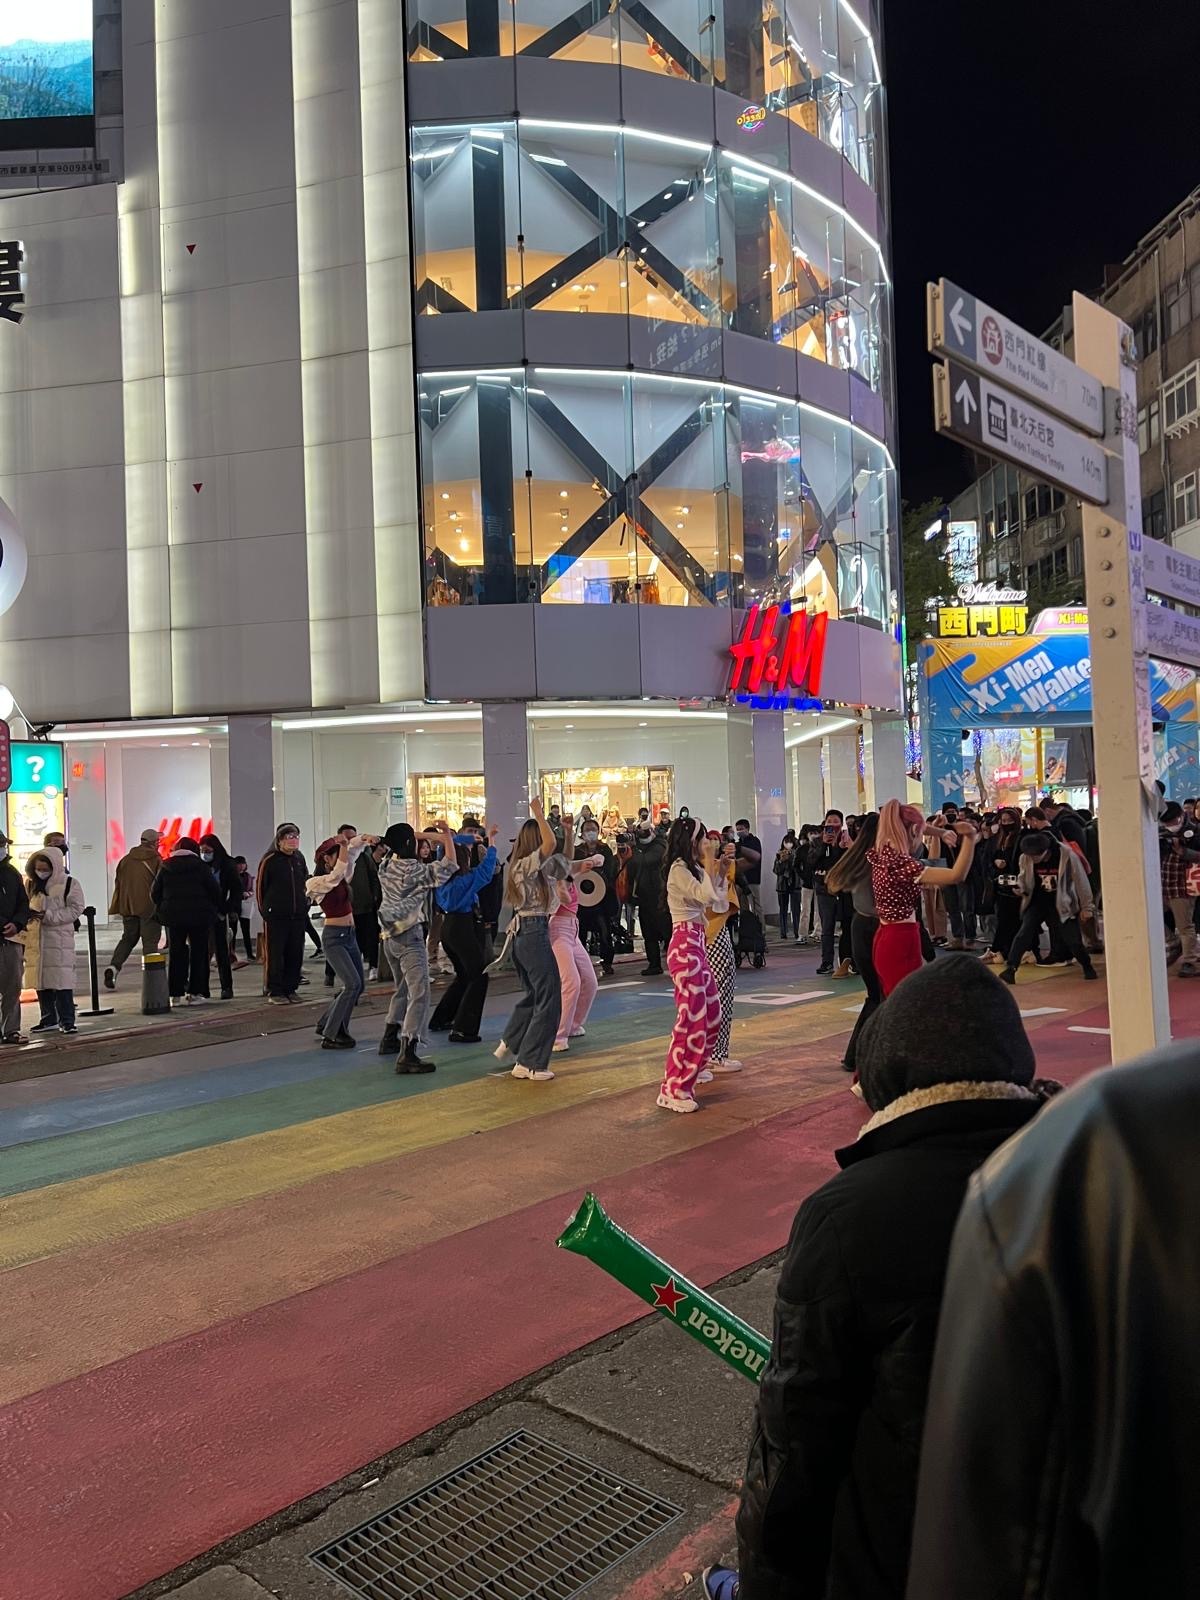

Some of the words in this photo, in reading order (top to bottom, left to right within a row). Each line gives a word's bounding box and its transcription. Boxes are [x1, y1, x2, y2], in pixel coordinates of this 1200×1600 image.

[1004, 328, 1046, 372] 西門紅樓
[1005, 356, 1017, 374] The
[1018, 364, 1030, 381] Red
[1030, 370, 1049, 392] House
[1081, 385, 1099, 411] 70m
[1009, 406, 1055, 449] 臺北天后宮
[1081, 455, 1102, 481] 140m
[957, 580, 1028, 603] Welcome
[938, 606, 1028, 637] 西門町
[1058, 612, 1088, 625] Xi-Me
[729, 603, 829, 697] H&M
[967, 651, 1054, 714] Xi-Men
[1019, 656, 1092, 713] Walke
